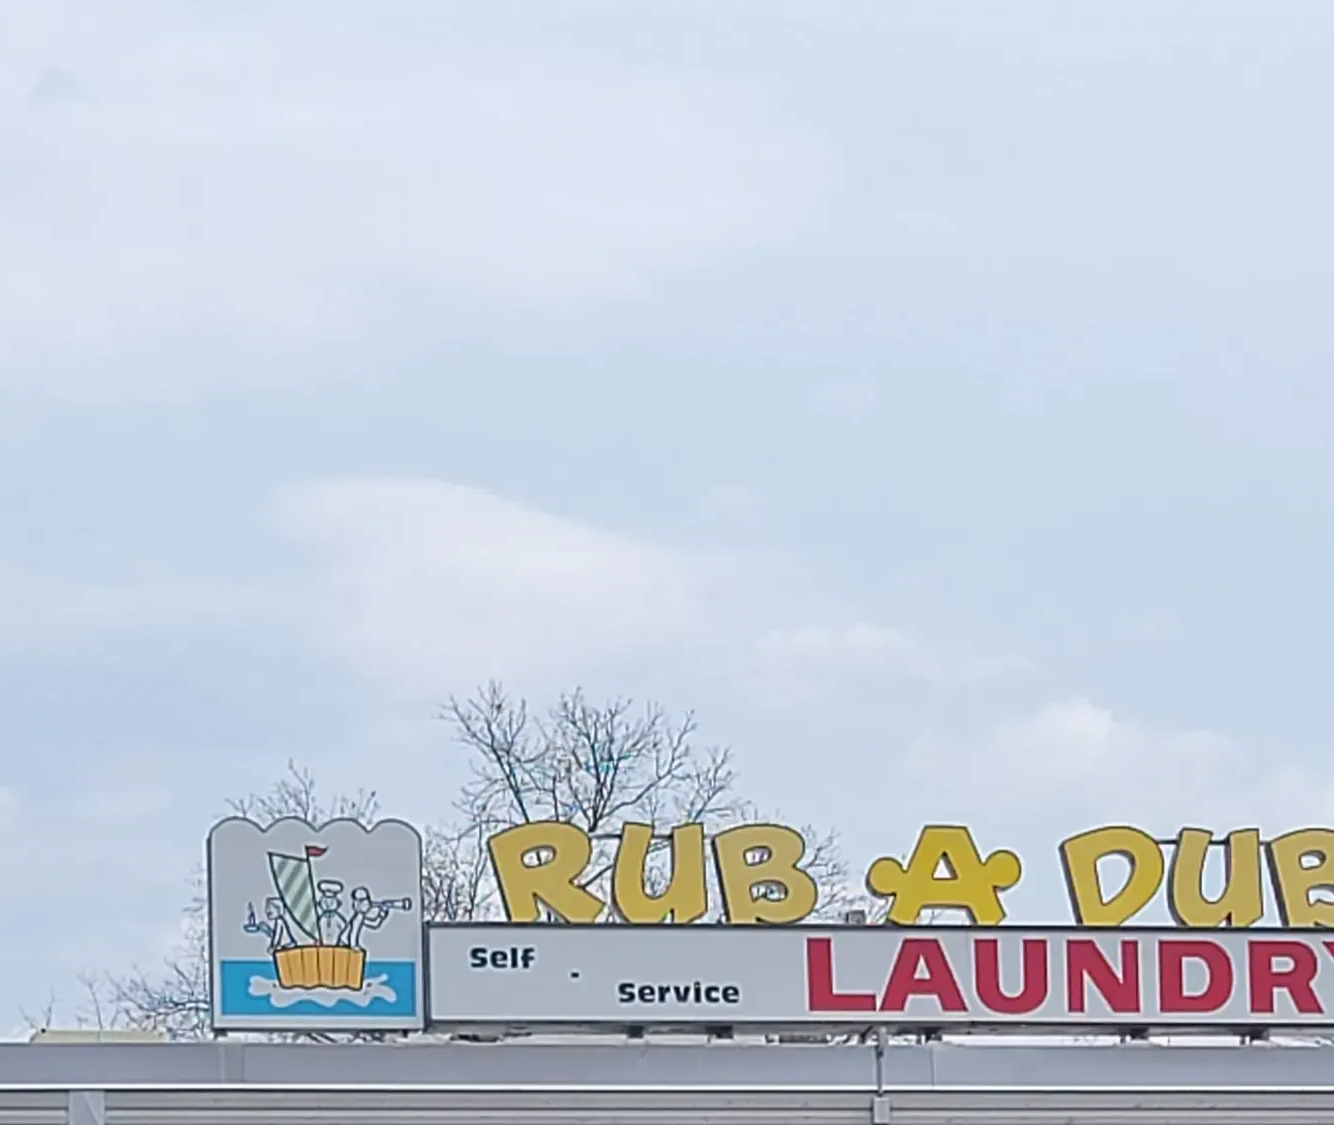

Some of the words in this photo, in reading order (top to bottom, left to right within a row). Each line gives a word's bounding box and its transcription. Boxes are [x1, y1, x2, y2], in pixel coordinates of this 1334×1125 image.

[488, 822, 818, 924] RUB
[869, 825, 1021, 925] A
[470, 946, 535, 969] Self
[618, 982, 740, 1004] Service
